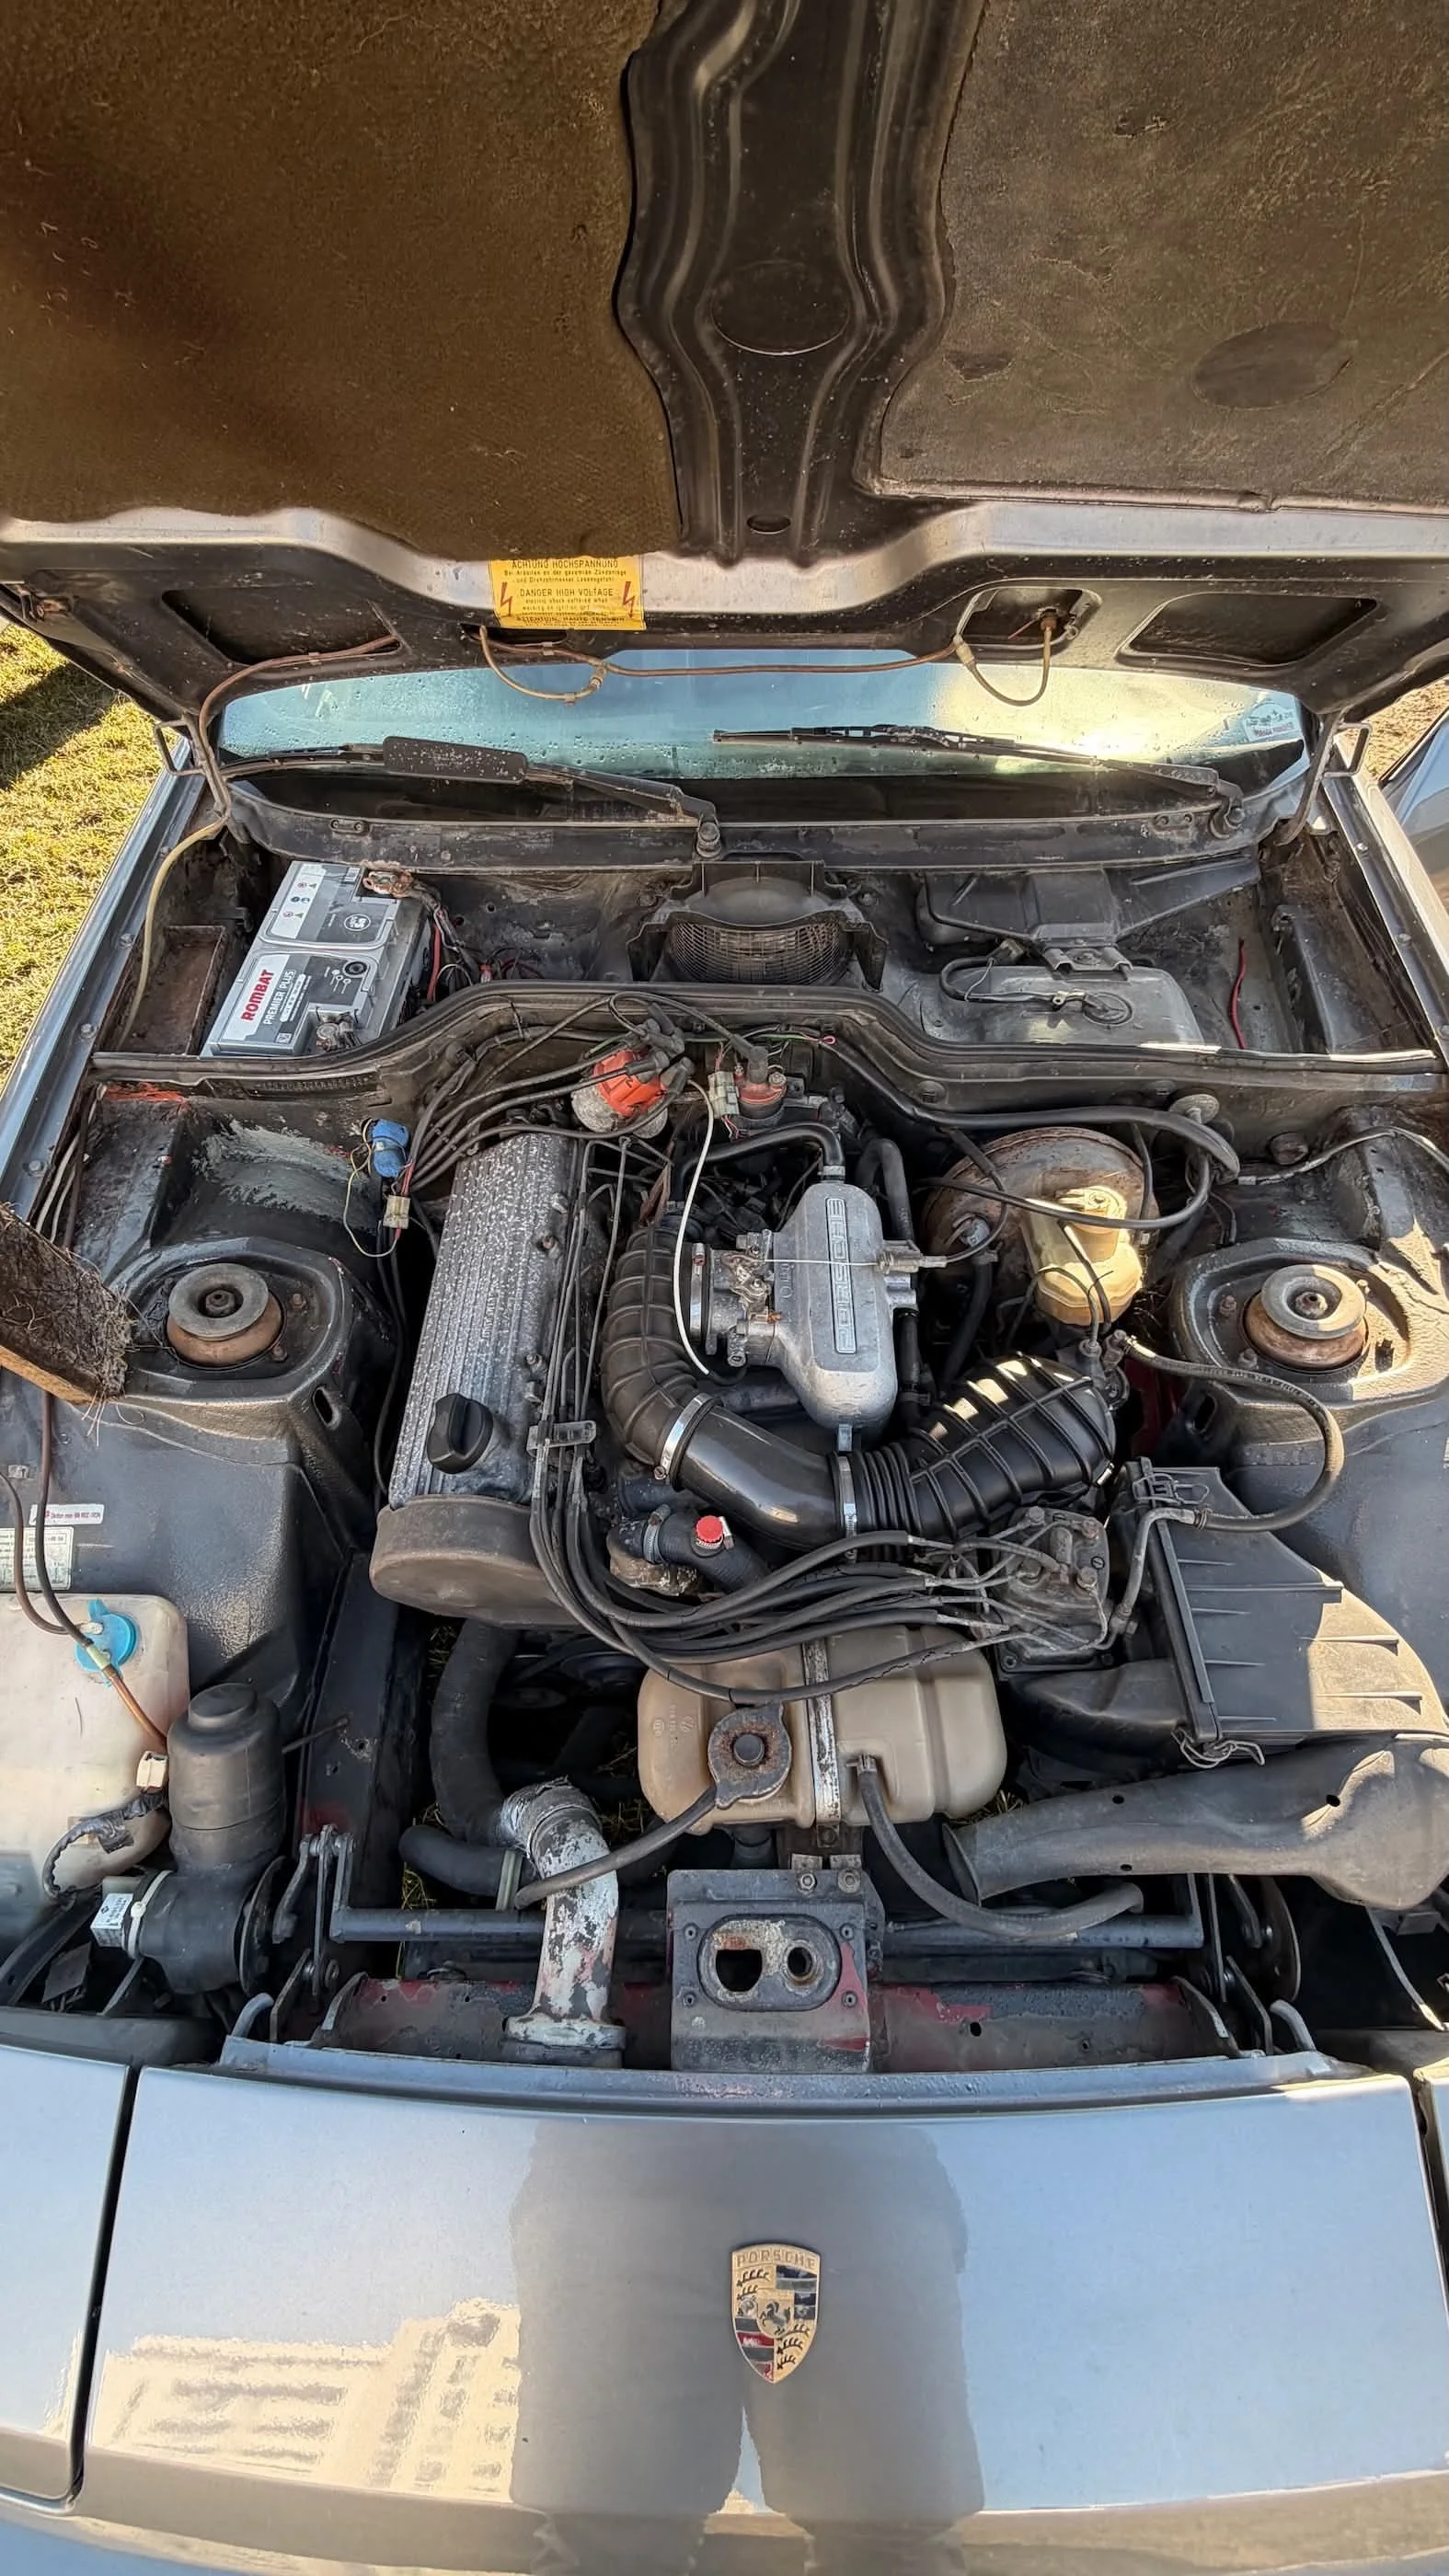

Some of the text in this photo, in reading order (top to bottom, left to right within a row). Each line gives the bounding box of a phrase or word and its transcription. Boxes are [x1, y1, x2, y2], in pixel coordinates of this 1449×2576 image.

[512, 559, 618, 569] ACHTUNG HOCHSPANNUNG
[520, 588, 614, 597] DANGER HIGH VOLTAGE
[241, 970, 274, 1021] ROMBAT
[263, 989, 284, 1025] PREMIER
[279, 971, 295, 991] PLUS
[828, 1200, 855, 1350] PORSCHE
[737, 2248, 816, 2269] PORSCHE
